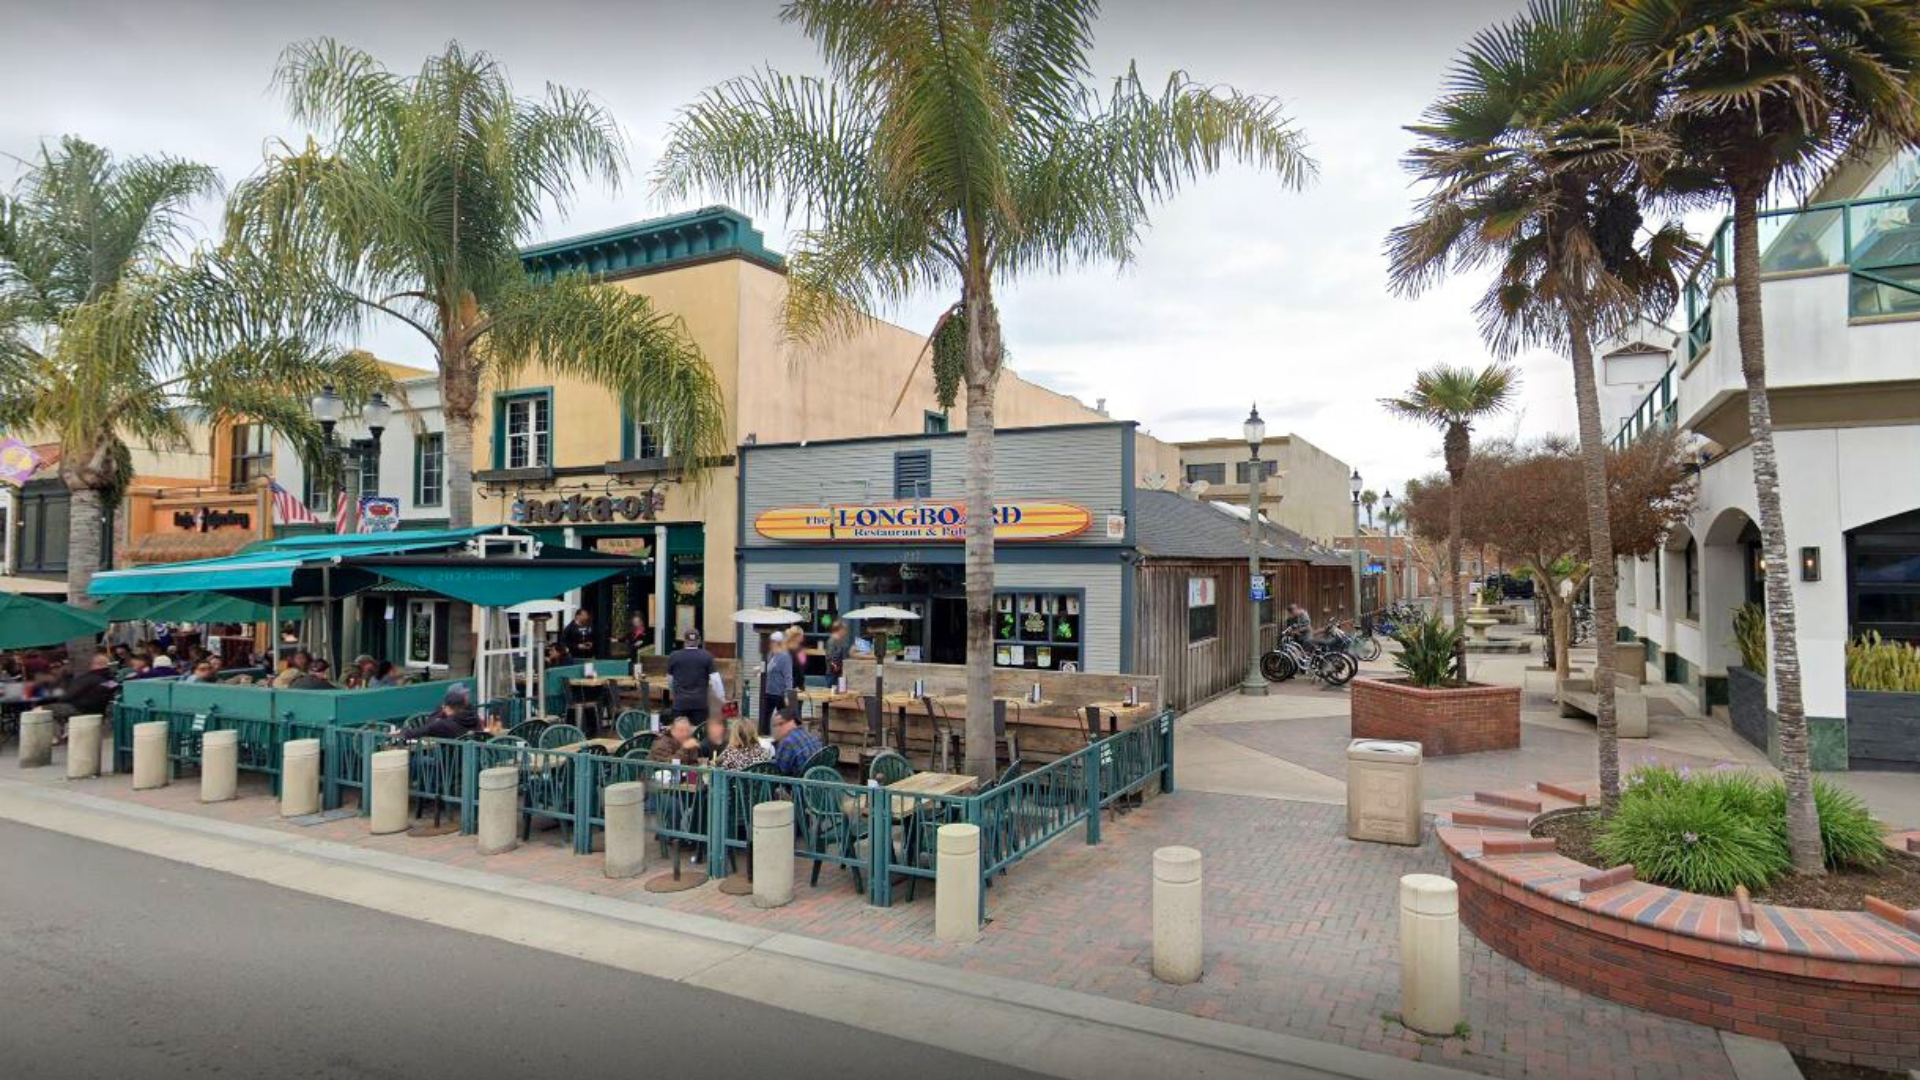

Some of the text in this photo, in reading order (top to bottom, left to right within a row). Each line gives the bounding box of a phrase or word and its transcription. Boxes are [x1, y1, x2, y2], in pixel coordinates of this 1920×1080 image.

[806, 506, 1022, 527] The LONGBOD
[854, 528, 921, 537] Restaurant
[926, 528, 937, 537] &
